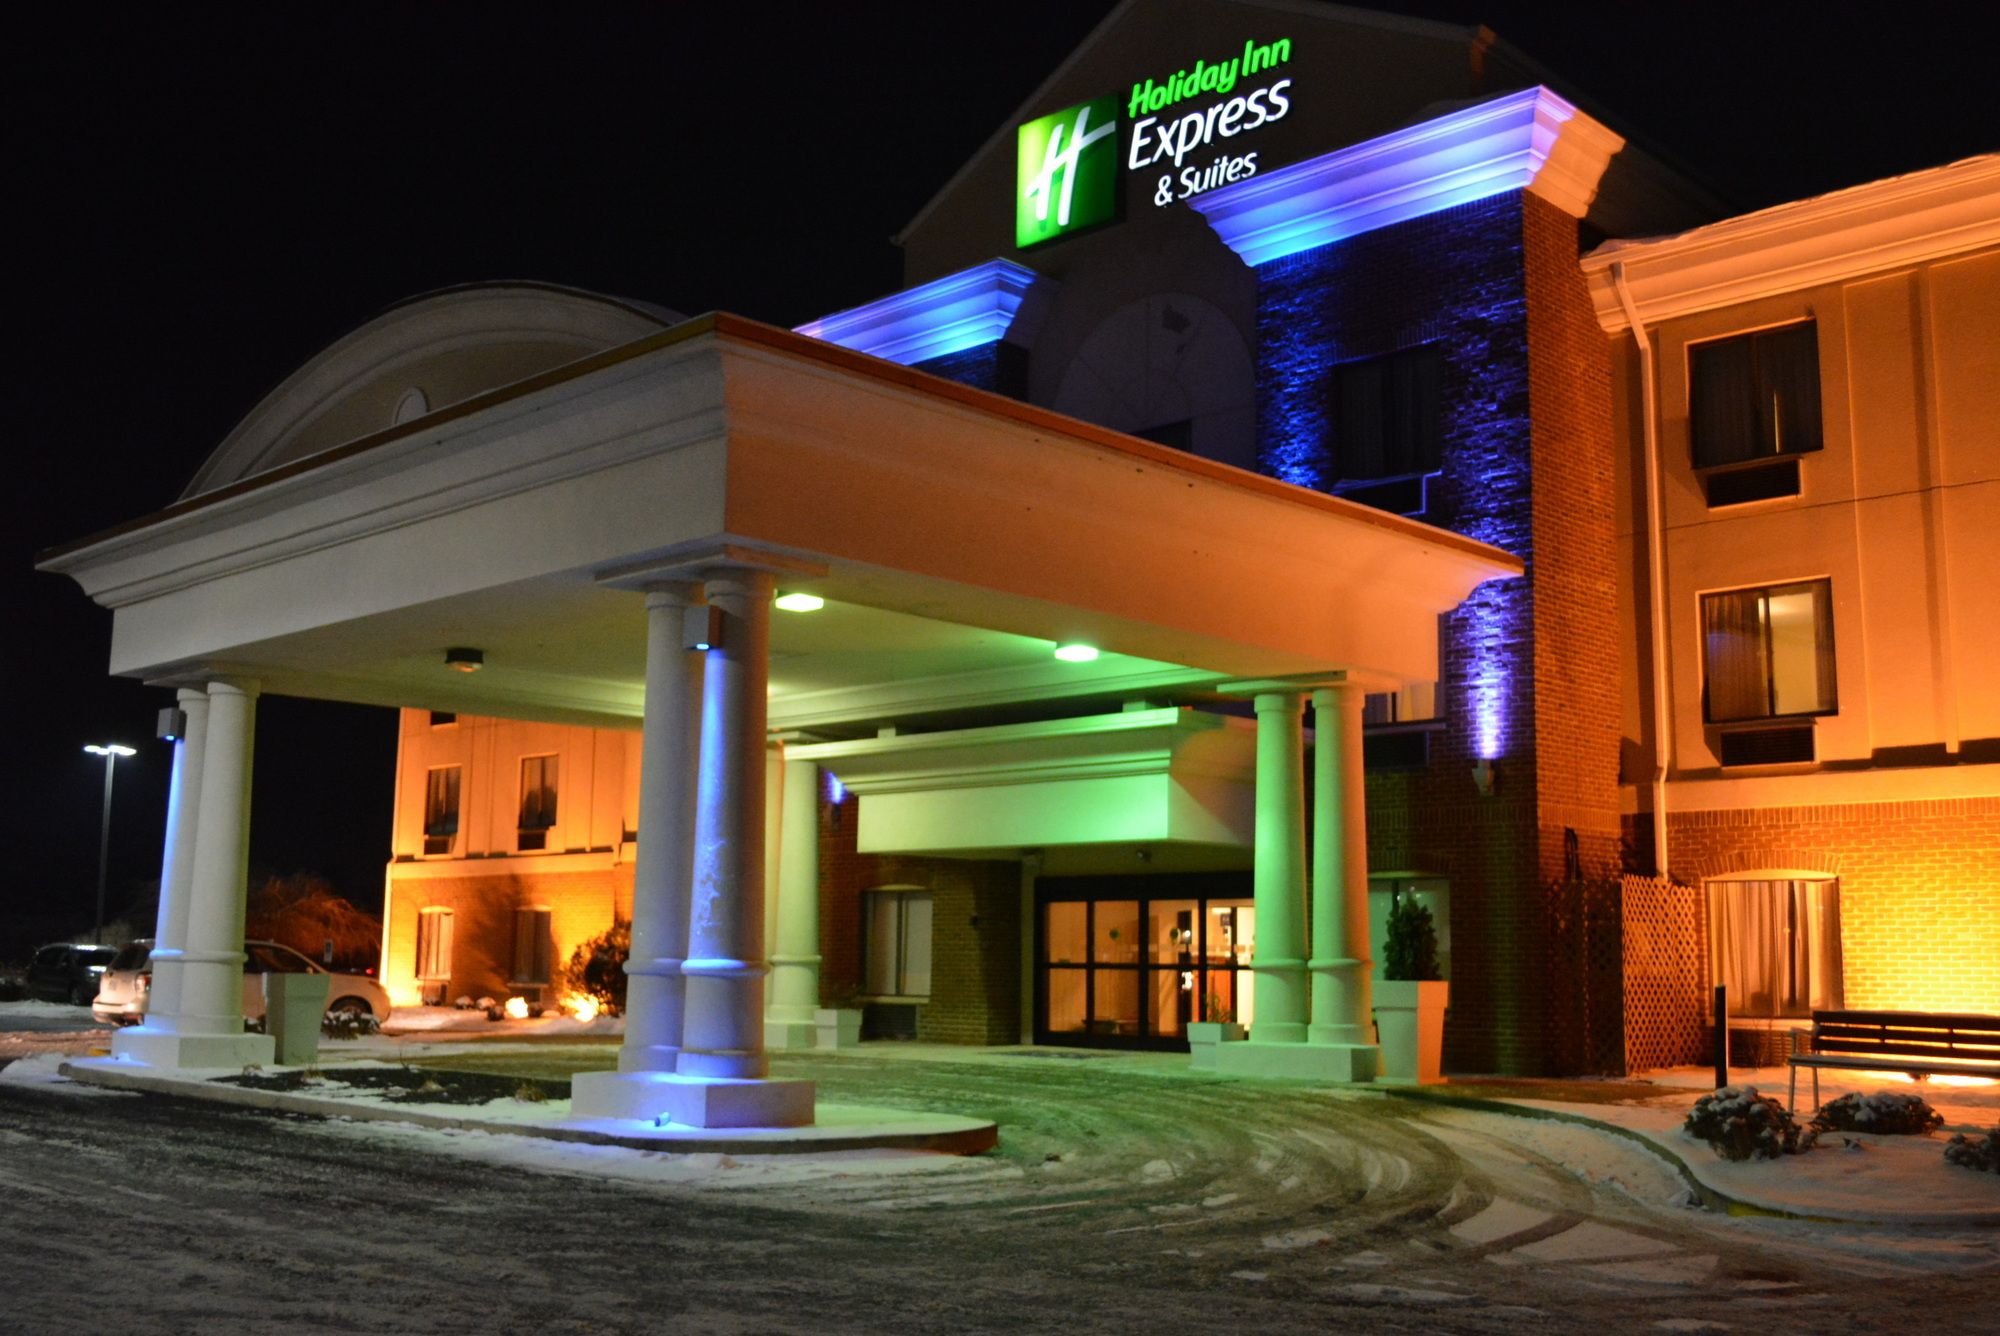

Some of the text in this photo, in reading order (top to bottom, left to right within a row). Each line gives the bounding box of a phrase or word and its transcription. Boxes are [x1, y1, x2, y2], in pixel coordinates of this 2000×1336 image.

[1128, 38, 1291, 118] Holiday Inn
[1024, 106, 1116, 226] H
[1128, 79, 1292, 170] Express
[1154, 152, 1258, 206] & Suites
